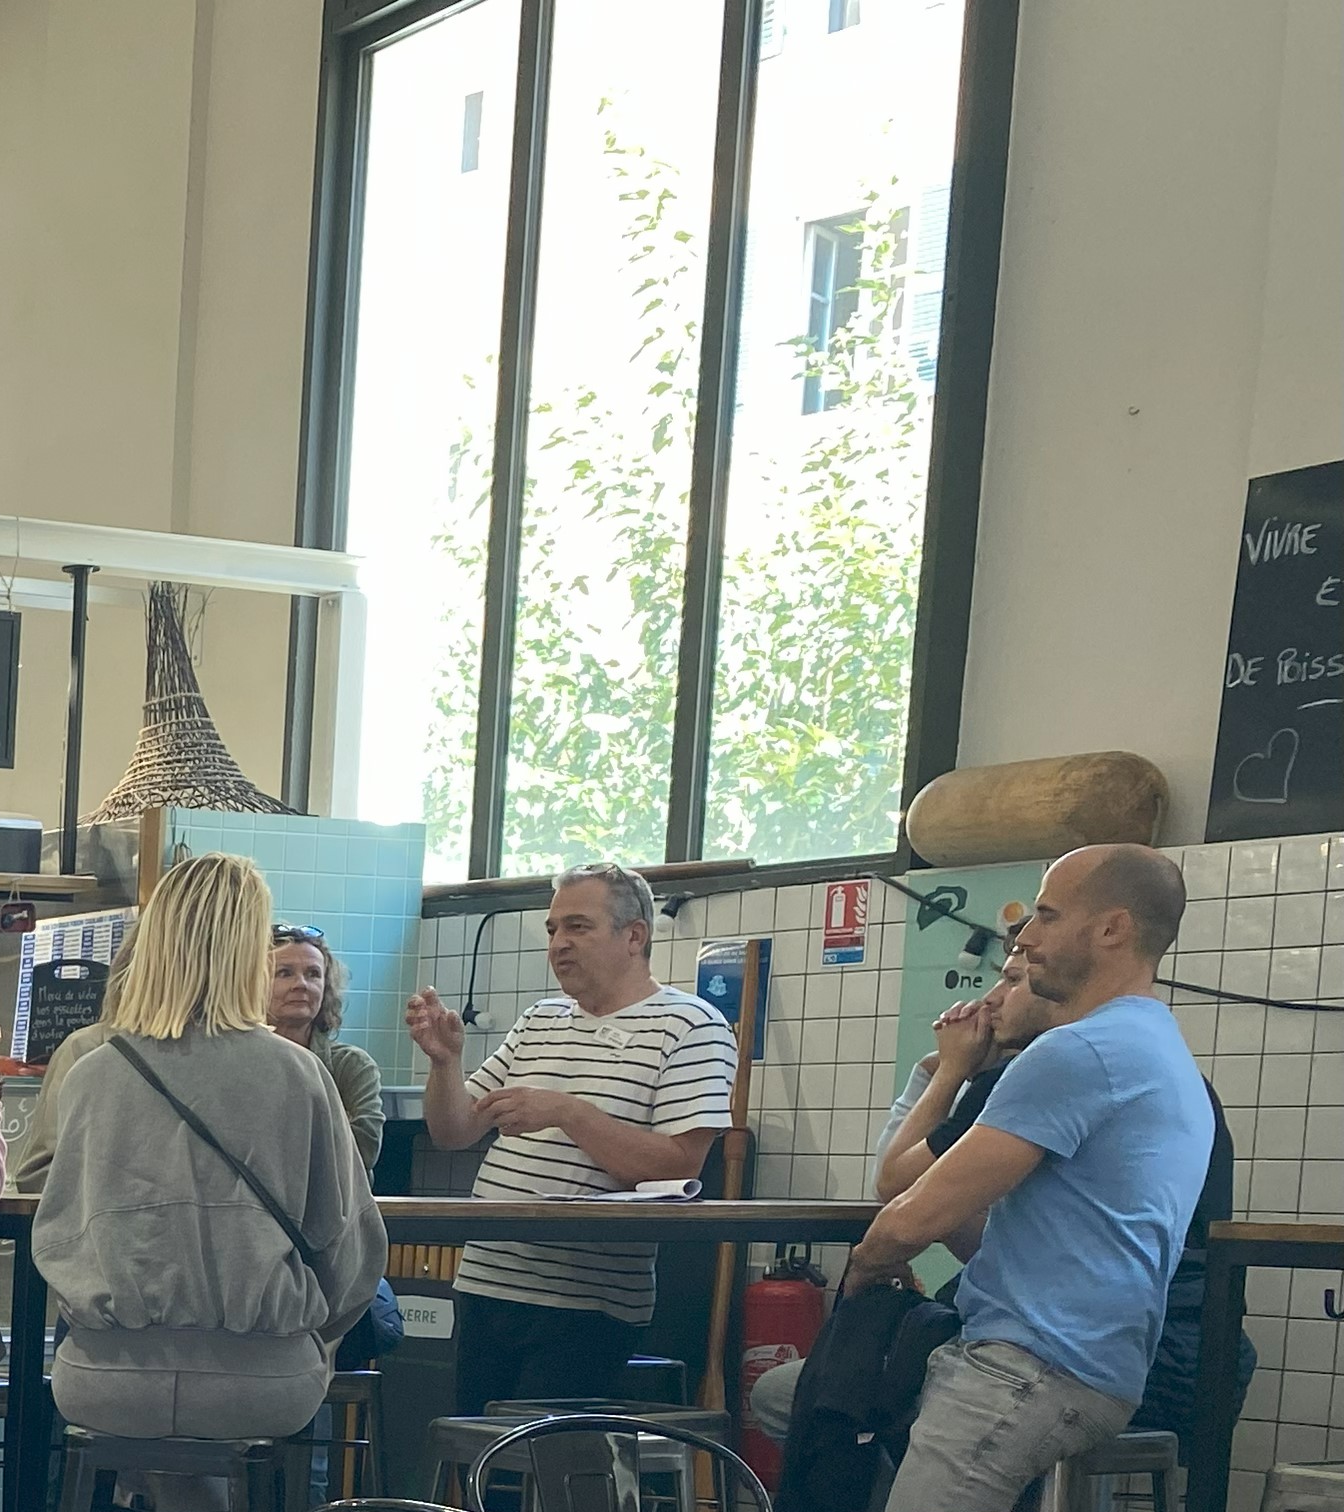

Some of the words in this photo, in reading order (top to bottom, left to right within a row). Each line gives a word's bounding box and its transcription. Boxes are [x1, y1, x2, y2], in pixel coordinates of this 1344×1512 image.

[1316, 575, 1344, 606] E
[1226, 651, 1265, 689] DE
[1276, 647, 1344, 686] POISS
[945, 969, 983, 991] One
[399, 1308, 437, 1324] VERRE
